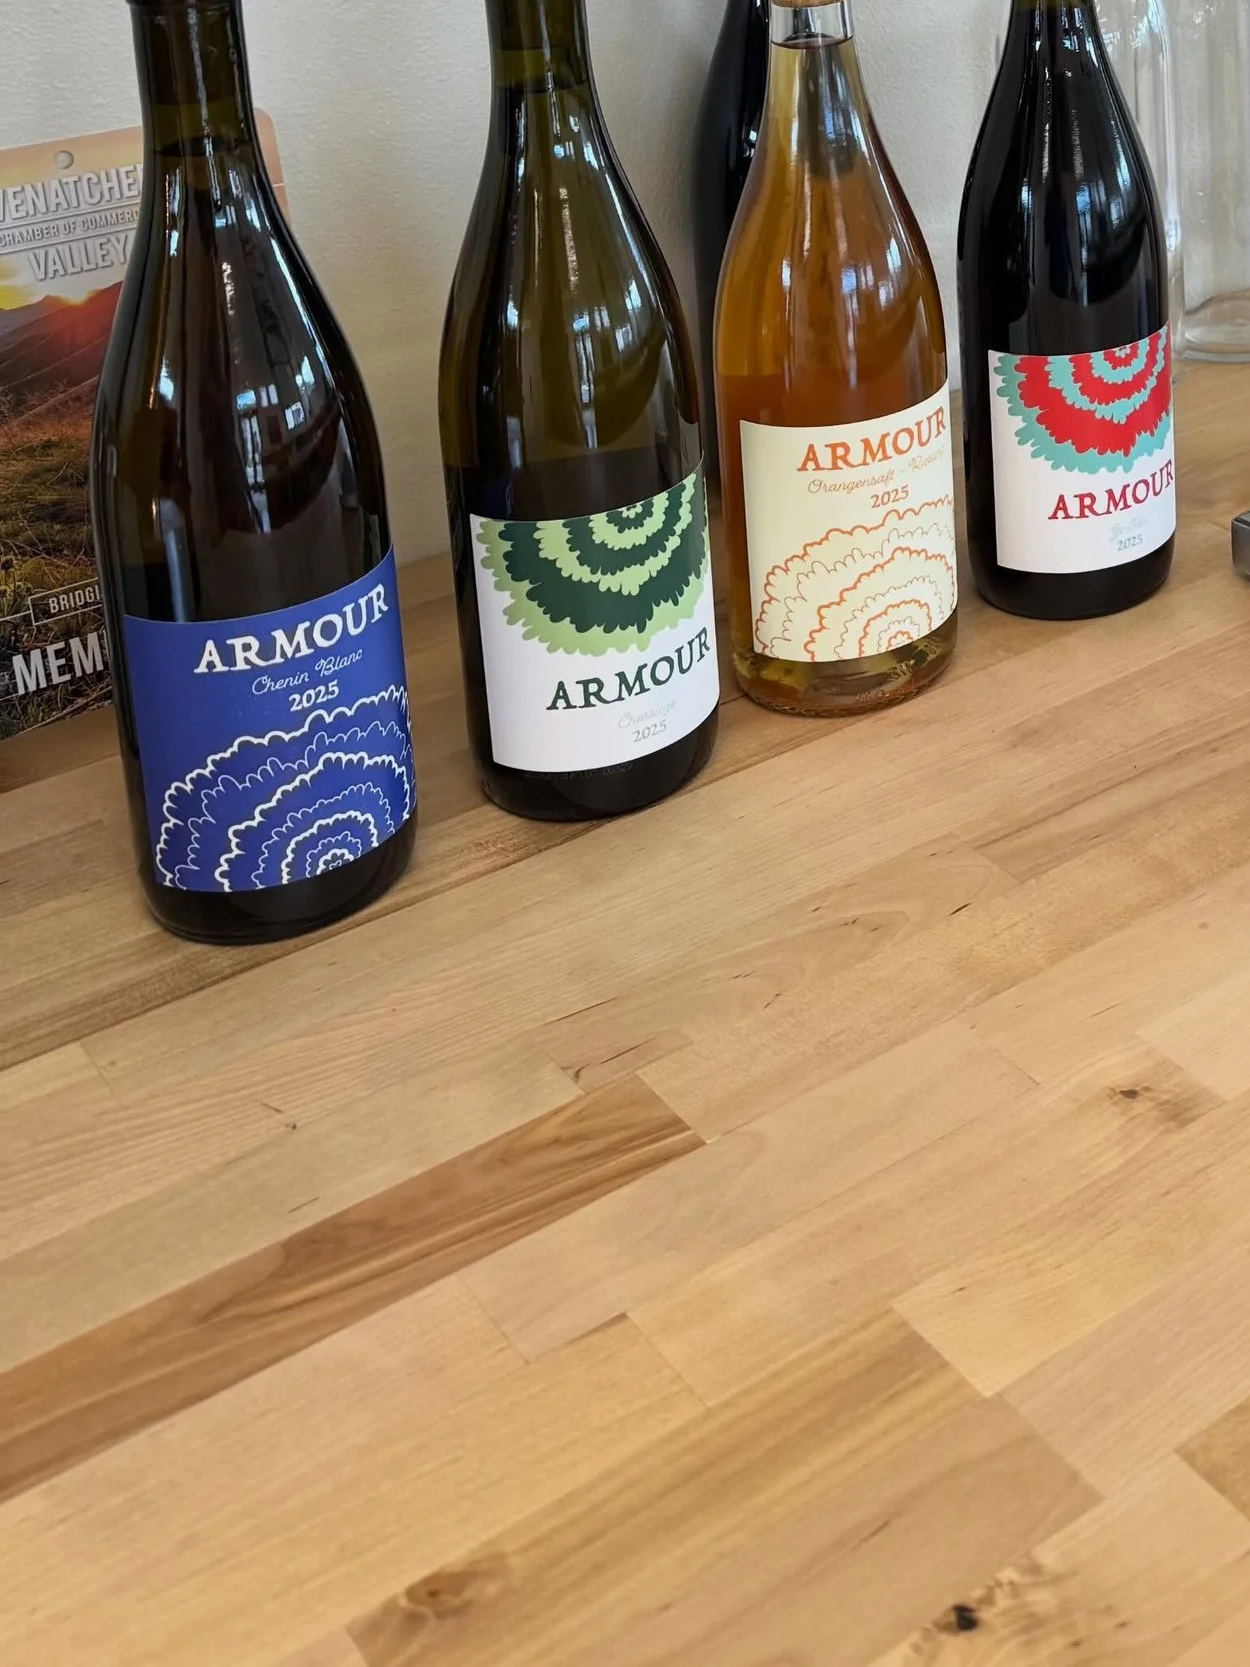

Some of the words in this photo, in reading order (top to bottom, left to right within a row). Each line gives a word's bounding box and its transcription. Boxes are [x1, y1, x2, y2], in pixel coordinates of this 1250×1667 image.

[62, 220, 78, 234] OF
[28, 234, 128, 282] VALLEY
[796, 405, 946, 472] ARMOUR
[870, 484, 909, 509] 2025
[1047, 459, 1174, 520] ARMOUR
[1117, 534, 1143, 551] 2025
[193, 583, 389, 674] ARMOUR
[12, 629, 110, 696] MEM
[252, 671, 309, 695] Chenin
[314, 649, 363, 677] Blanc
[546, 626, 711, 711] ARMOUR
[288, 679, 339, 712] 2025
[632, 719, 667, 743] 2025
